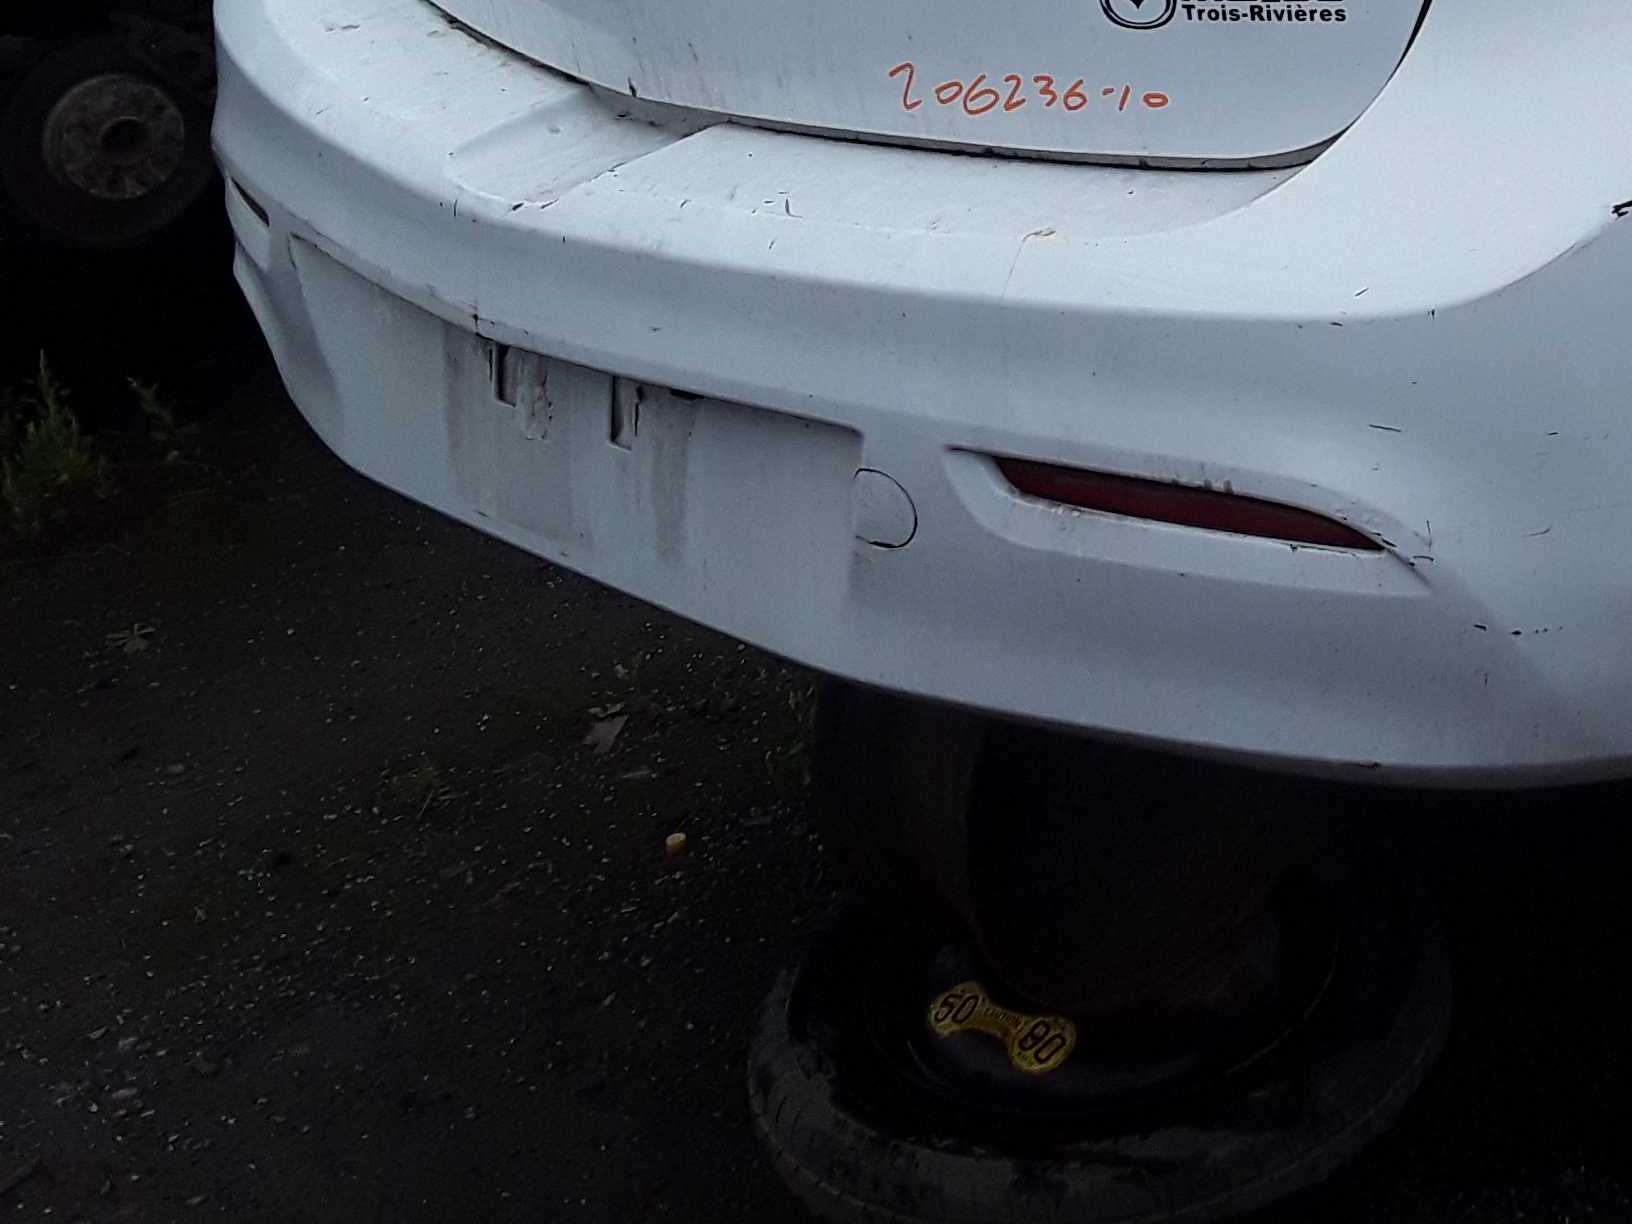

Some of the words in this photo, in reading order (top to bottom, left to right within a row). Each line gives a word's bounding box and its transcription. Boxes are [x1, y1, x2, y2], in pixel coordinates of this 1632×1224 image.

[1181, 4, 1348, 23] Trois-Rivières
[888, 61, 1170, 116] 206236-10
[934, 992, 980, 1025] 50
